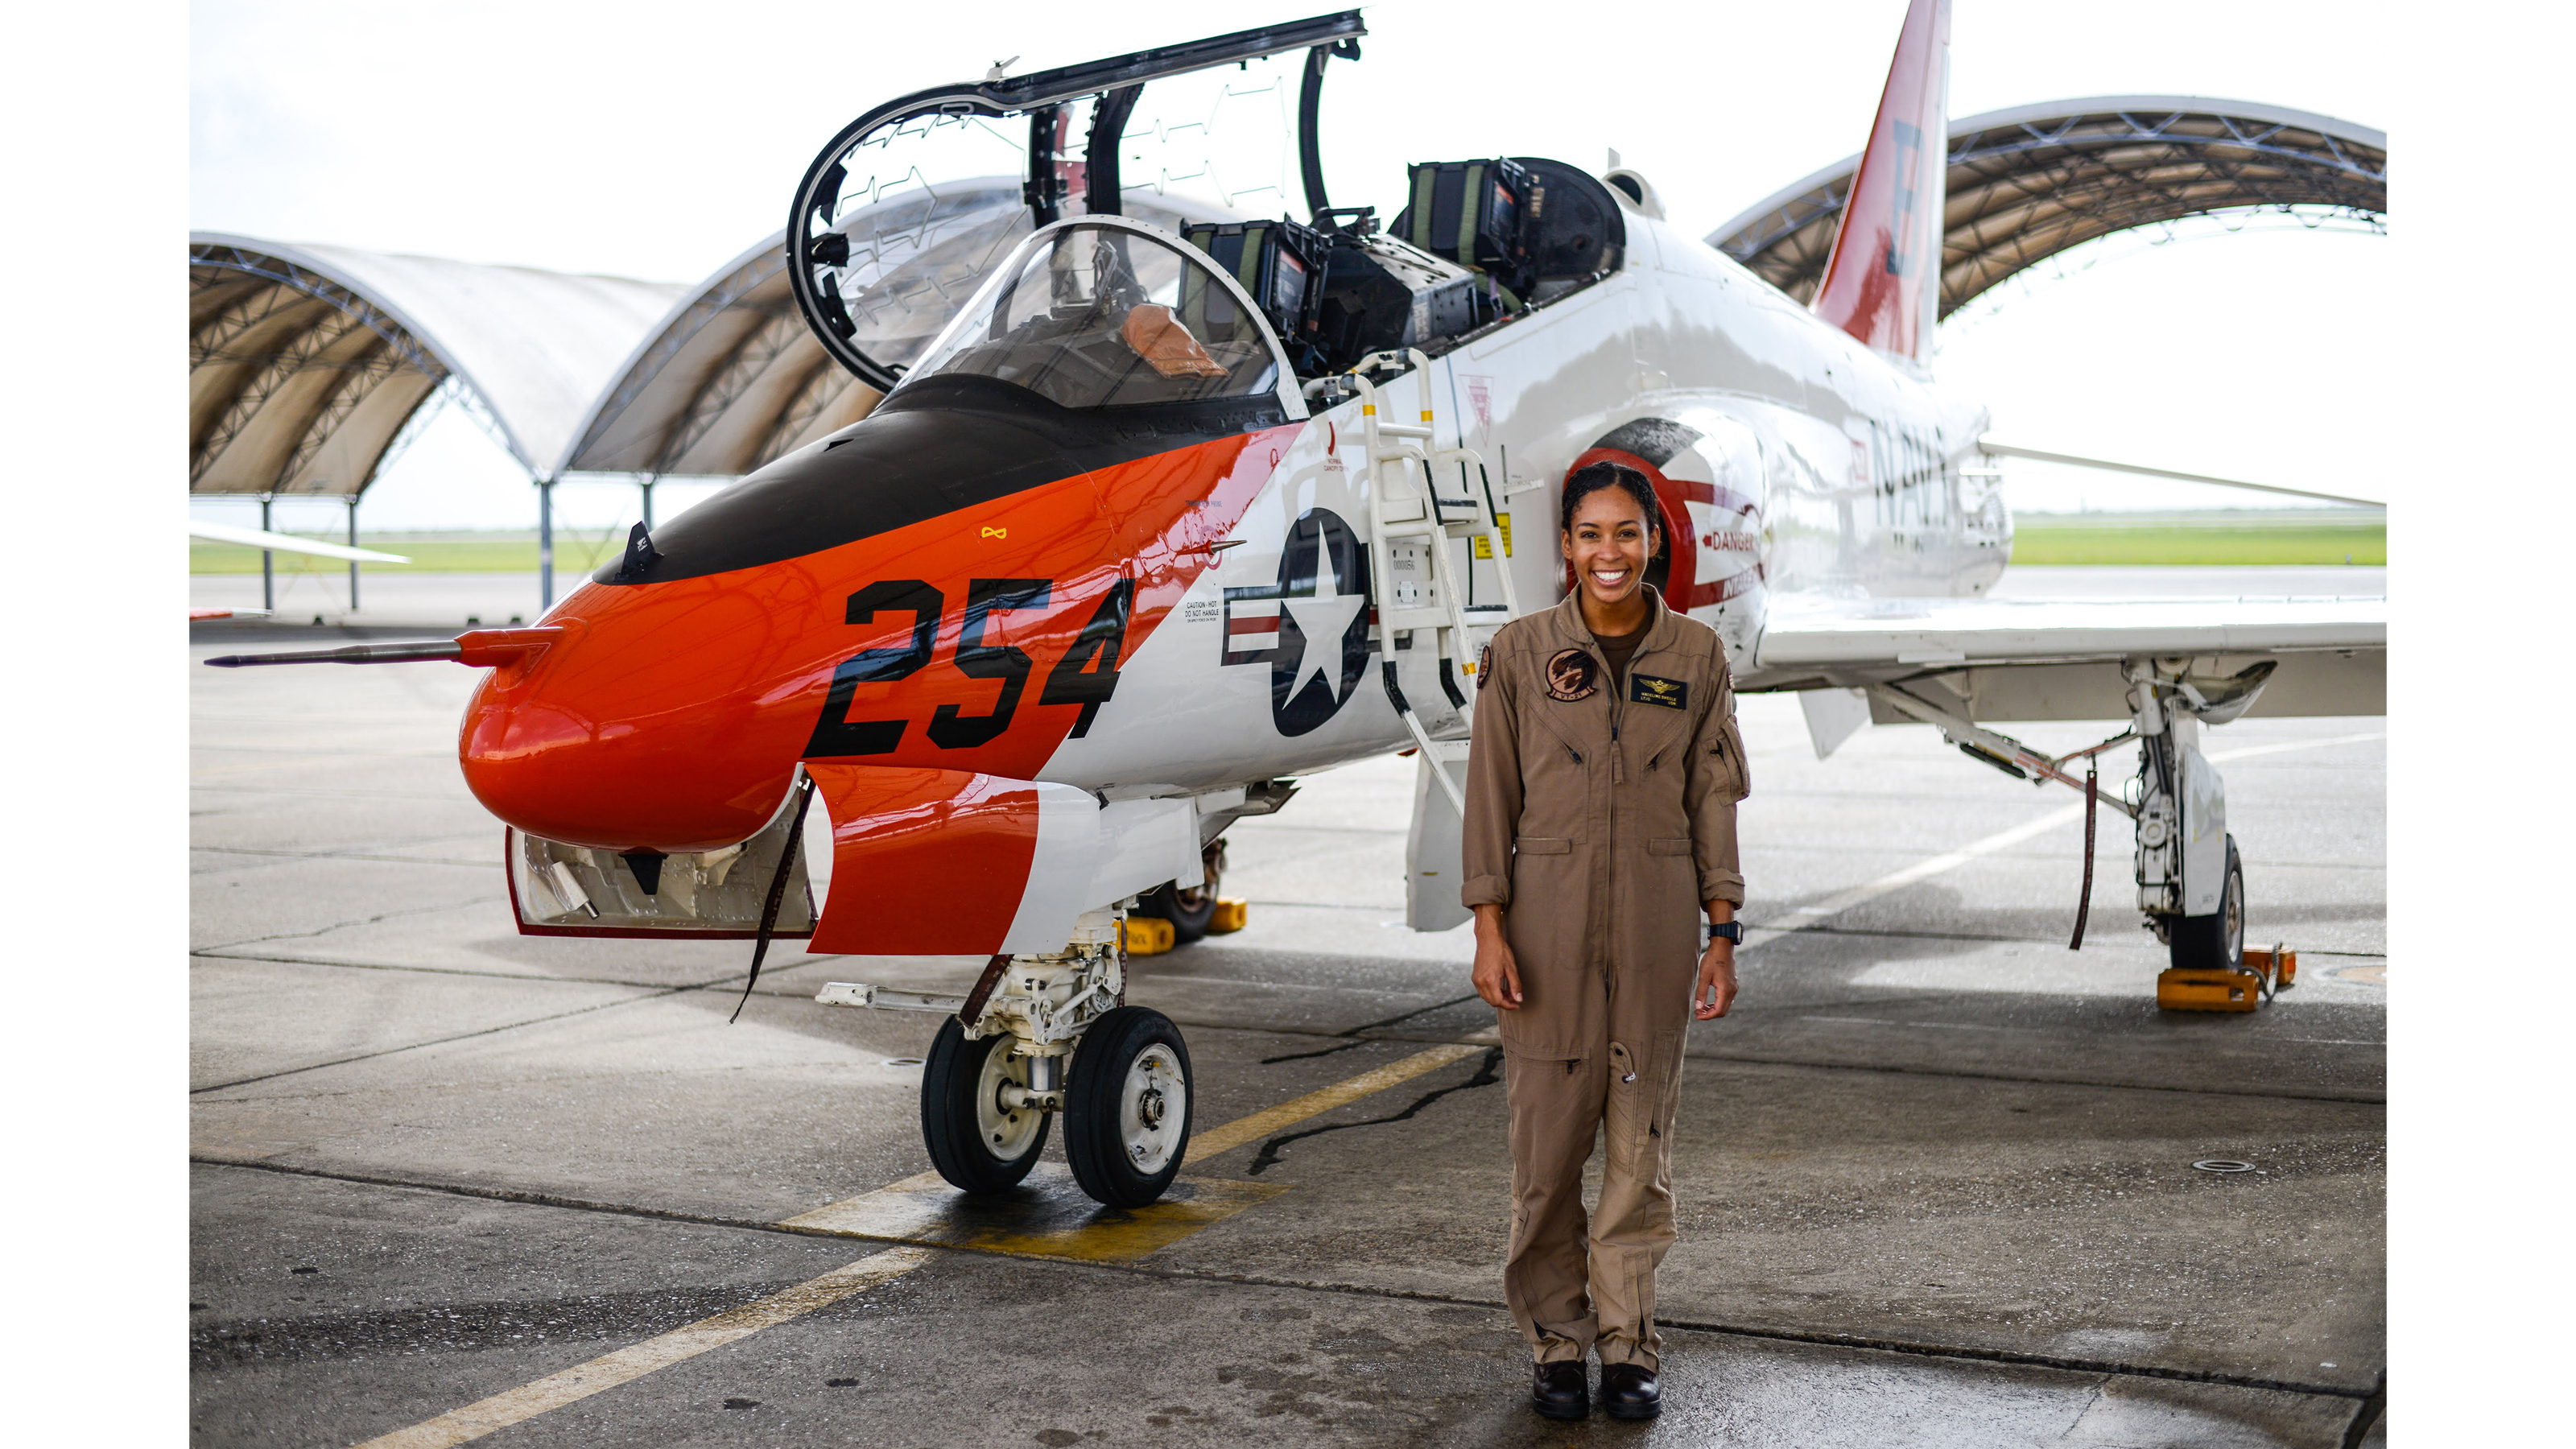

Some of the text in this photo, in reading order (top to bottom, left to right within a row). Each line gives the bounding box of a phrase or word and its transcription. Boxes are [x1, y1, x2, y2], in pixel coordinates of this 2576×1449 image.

[1712, 531, 1754, 551] DANGER
[1187, 601, 1206, 609] CAUTION
[1192, 609, 1201, 617] NOT
[1202, 609, 1220, 617] HANDLE
[801, 578, 1136, 758] 254
[1560, 692, 1583, 700] VT-21
